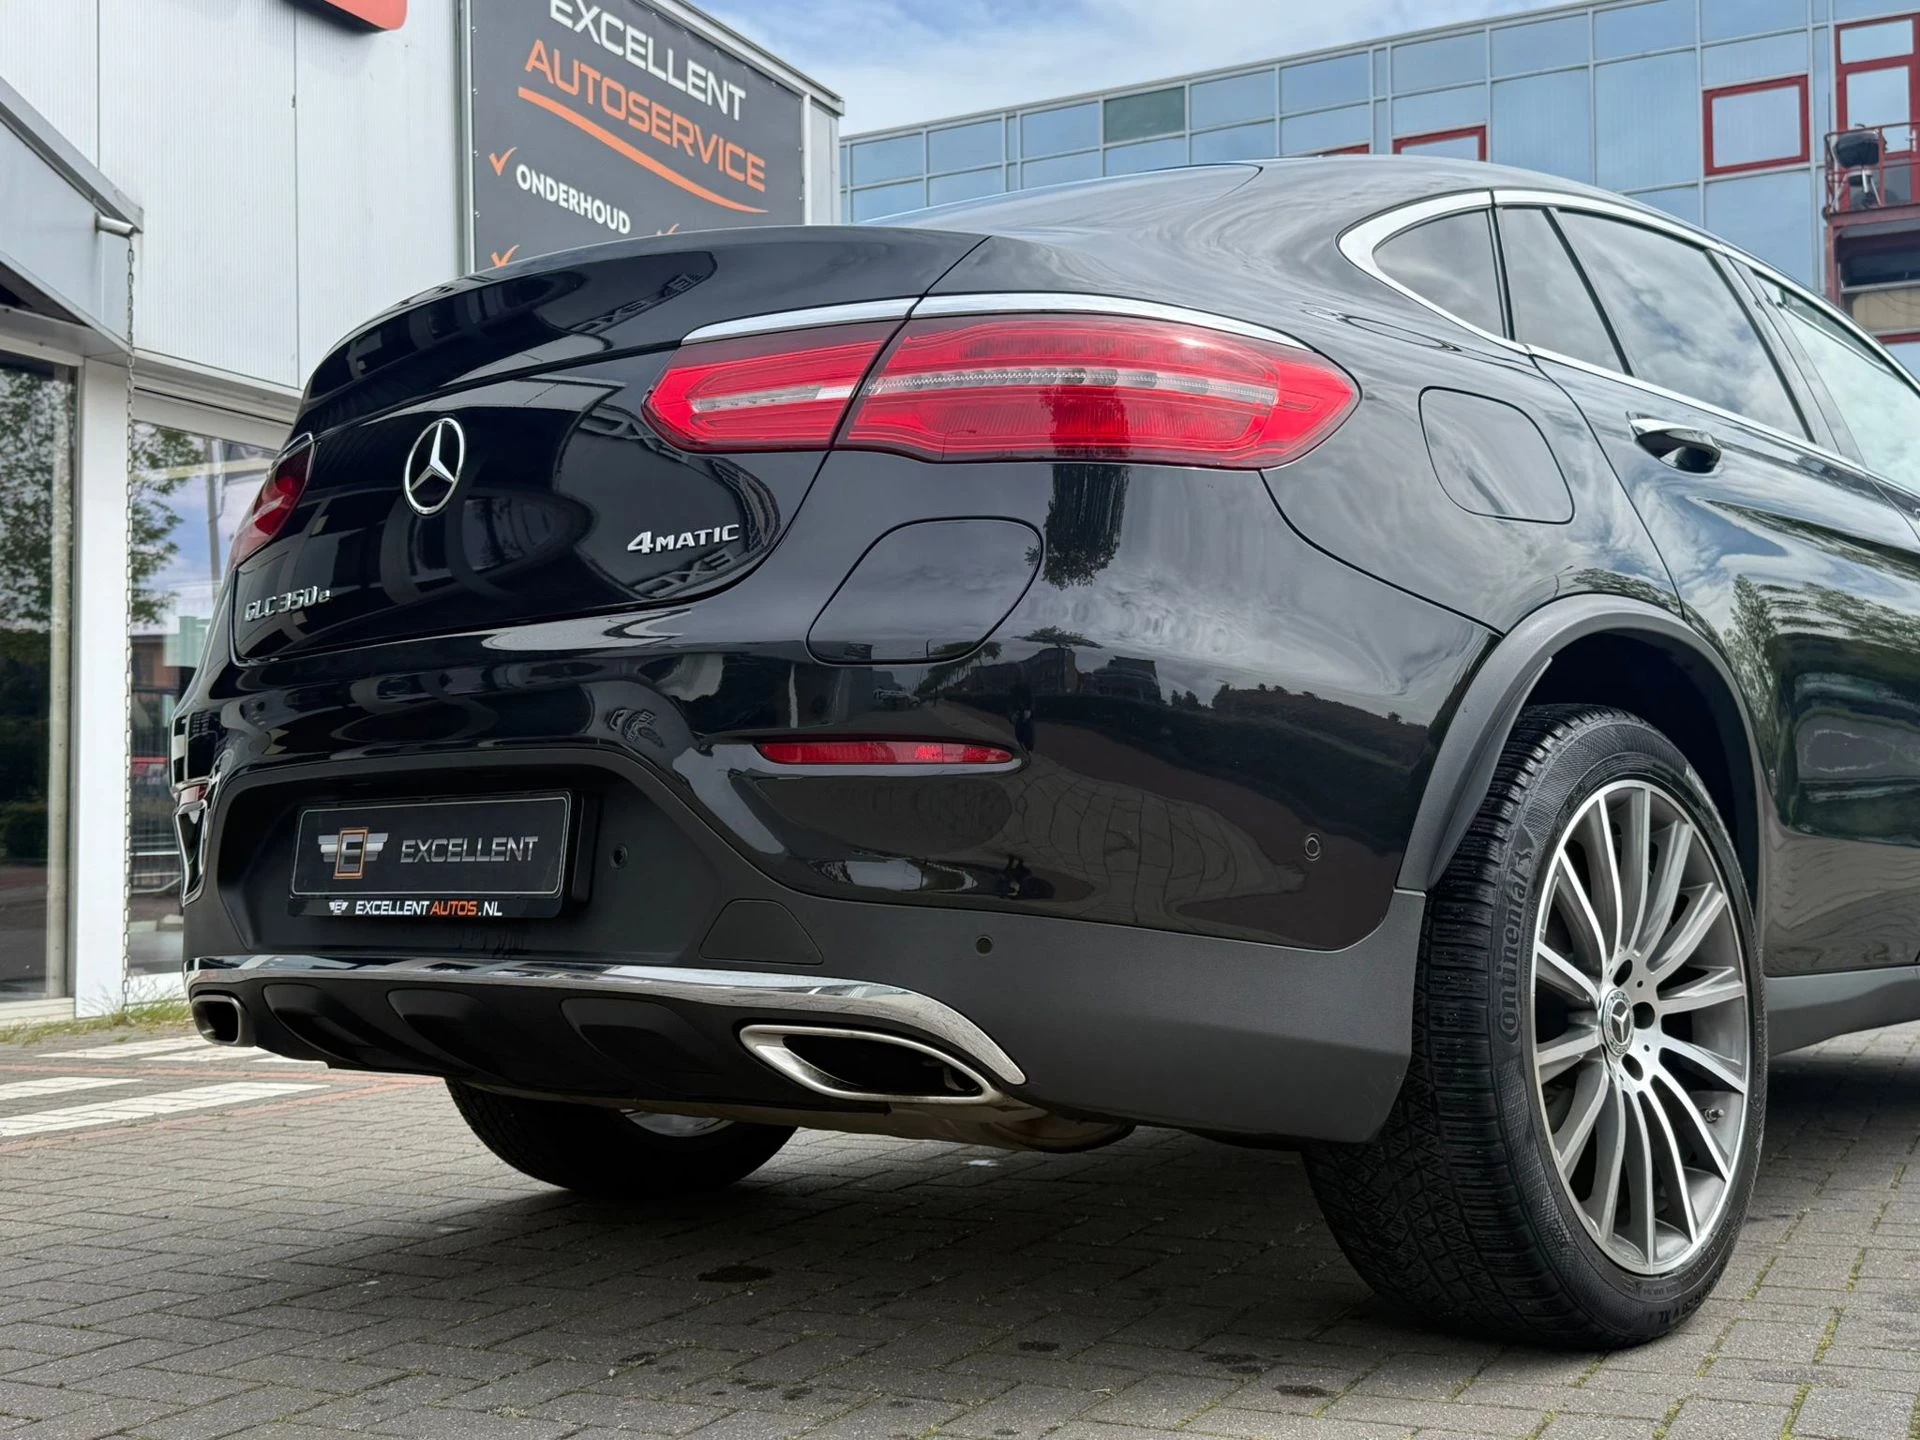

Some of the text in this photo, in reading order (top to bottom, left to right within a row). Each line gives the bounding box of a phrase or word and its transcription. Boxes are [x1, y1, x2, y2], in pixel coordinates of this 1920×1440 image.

[550, 0, 746, 121] EXCELLENT
[525, 39, 766, 192] AUTOSERVICE
[516, 164, 631, 234] ONDERHOUD
[627, 524, 740, 553] 4MATIC
[245, 596, 277, 622] GLC
[400, 836, 539, 863] EXCELLENT
[1496, 867, 1529, 1043] Continental
